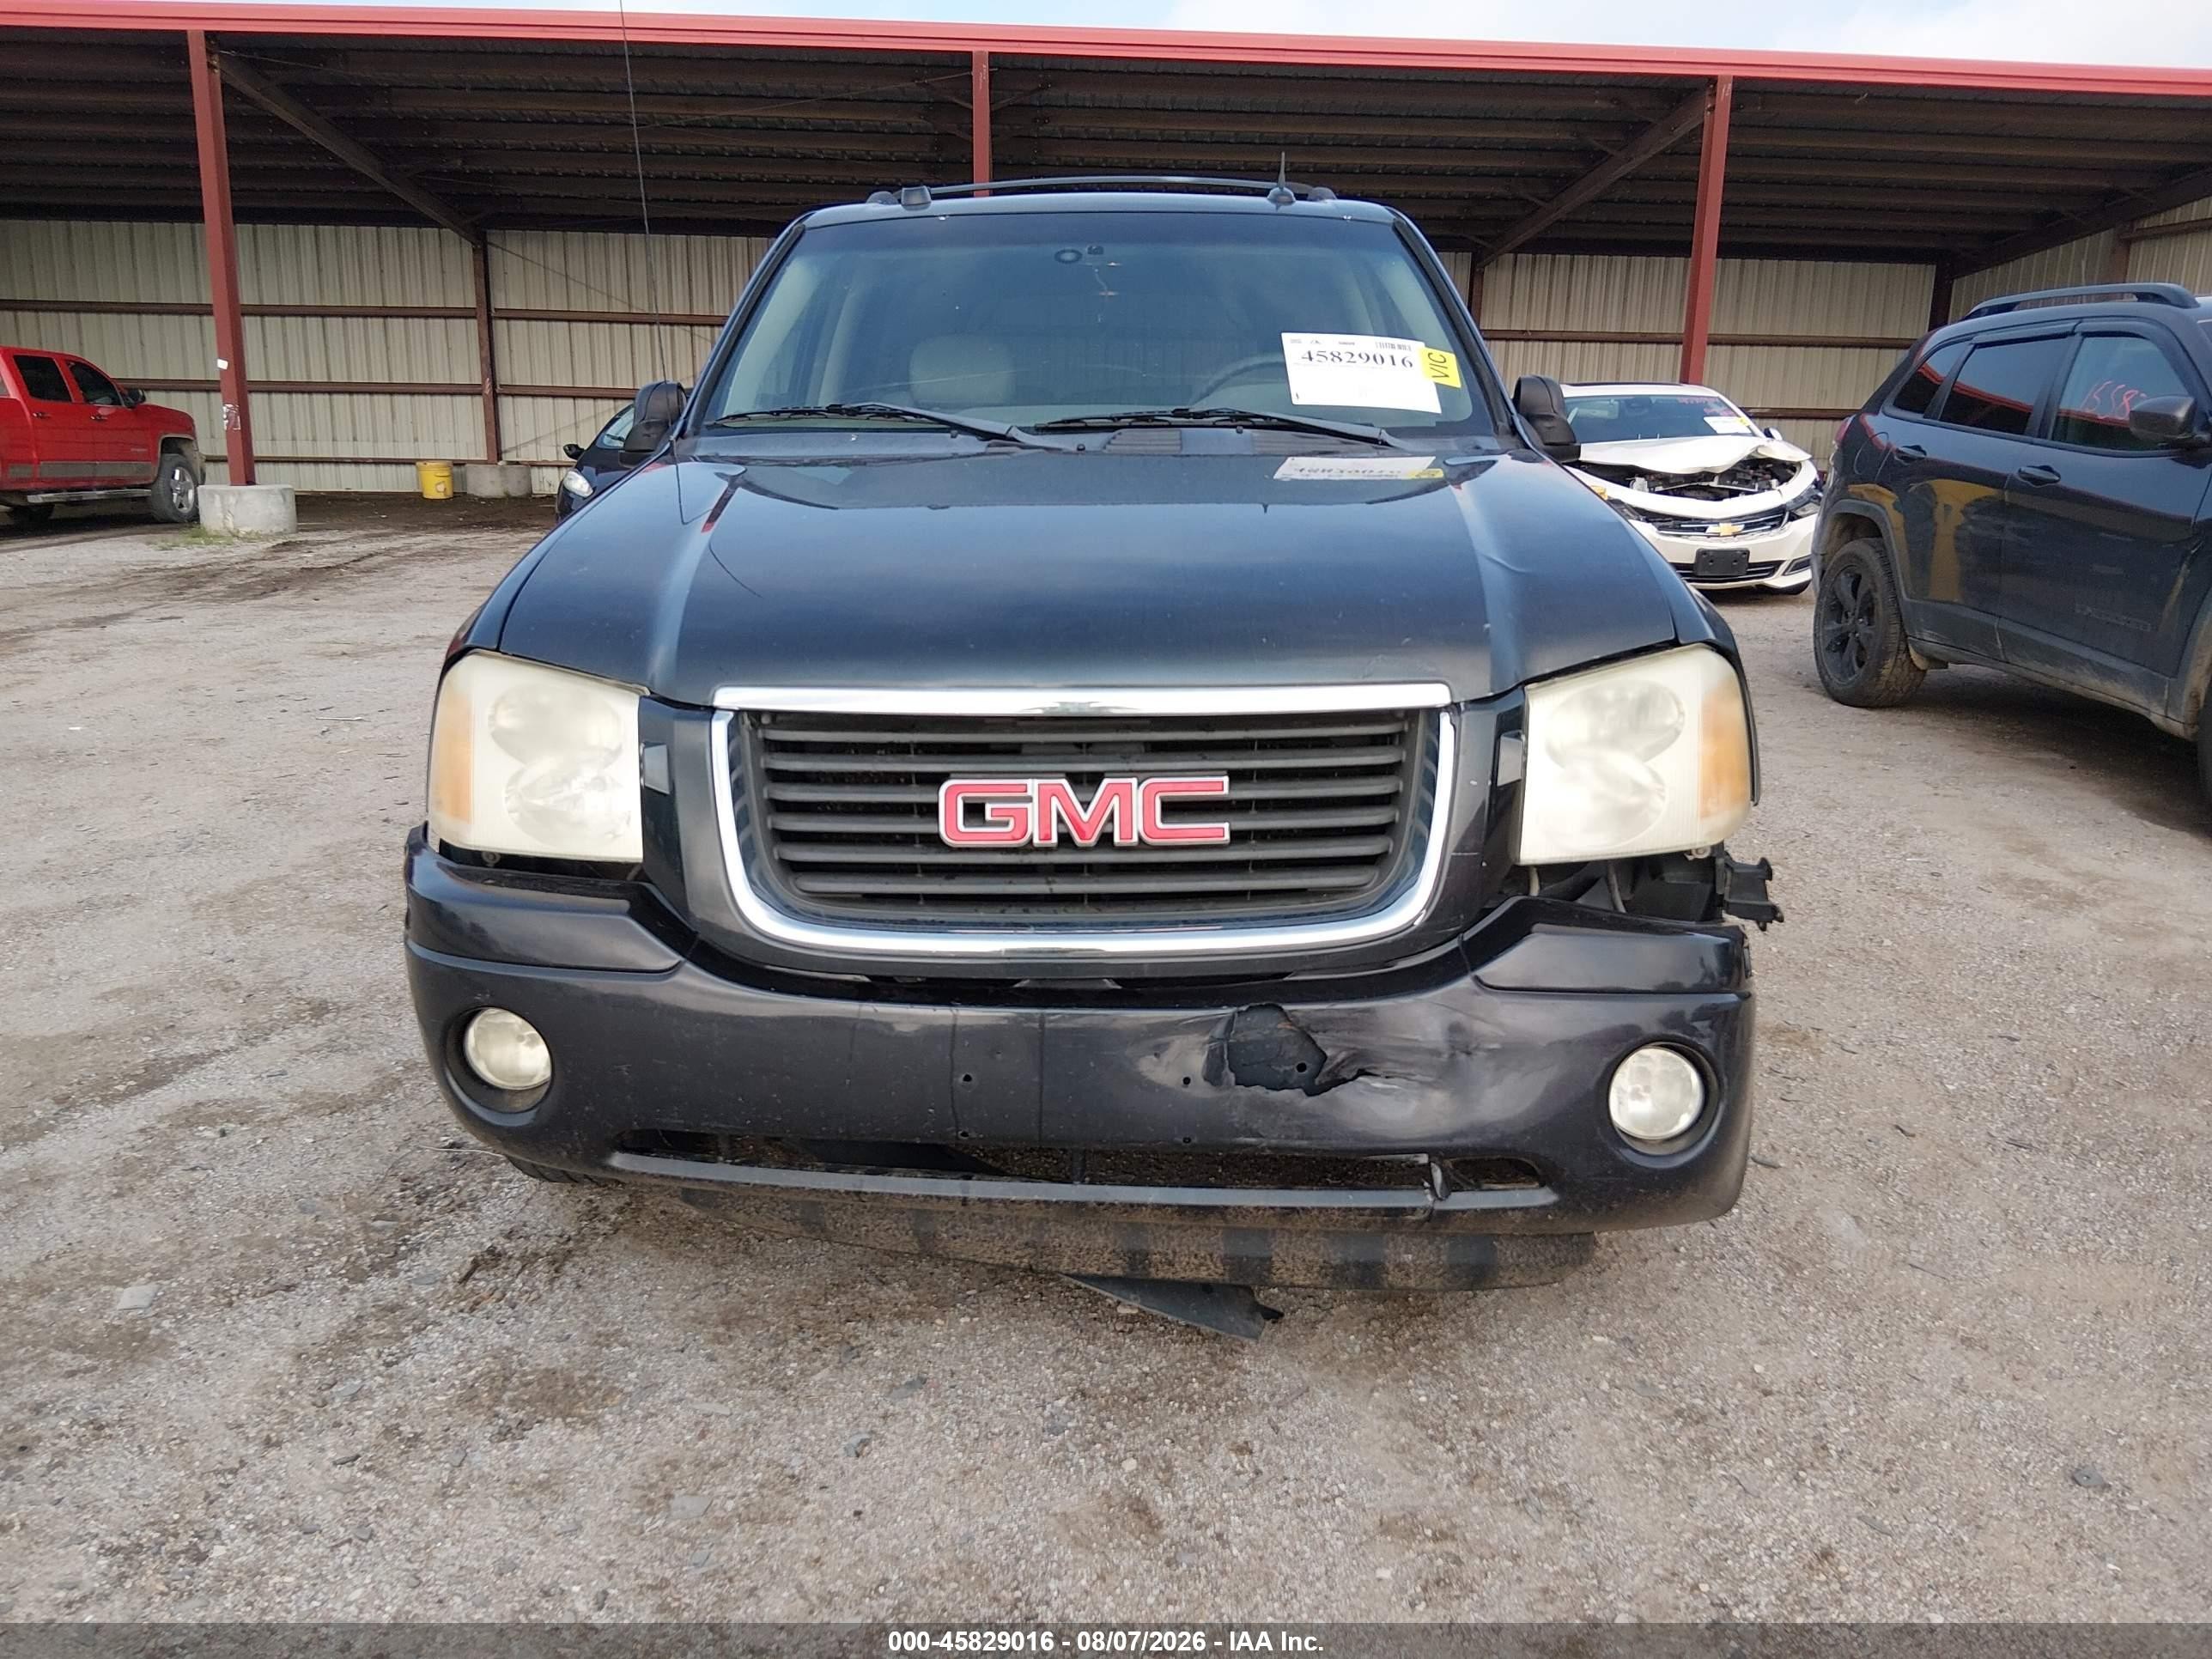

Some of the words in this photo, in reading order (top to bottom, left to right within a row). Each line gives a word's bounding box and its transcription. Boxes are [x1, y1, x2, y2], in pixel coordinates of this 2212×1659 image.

[1301, 349, 1414, 369] 45829016
[1427, 352, 1450, 379] VIC
[939, 775, 1230, 848] GMC
